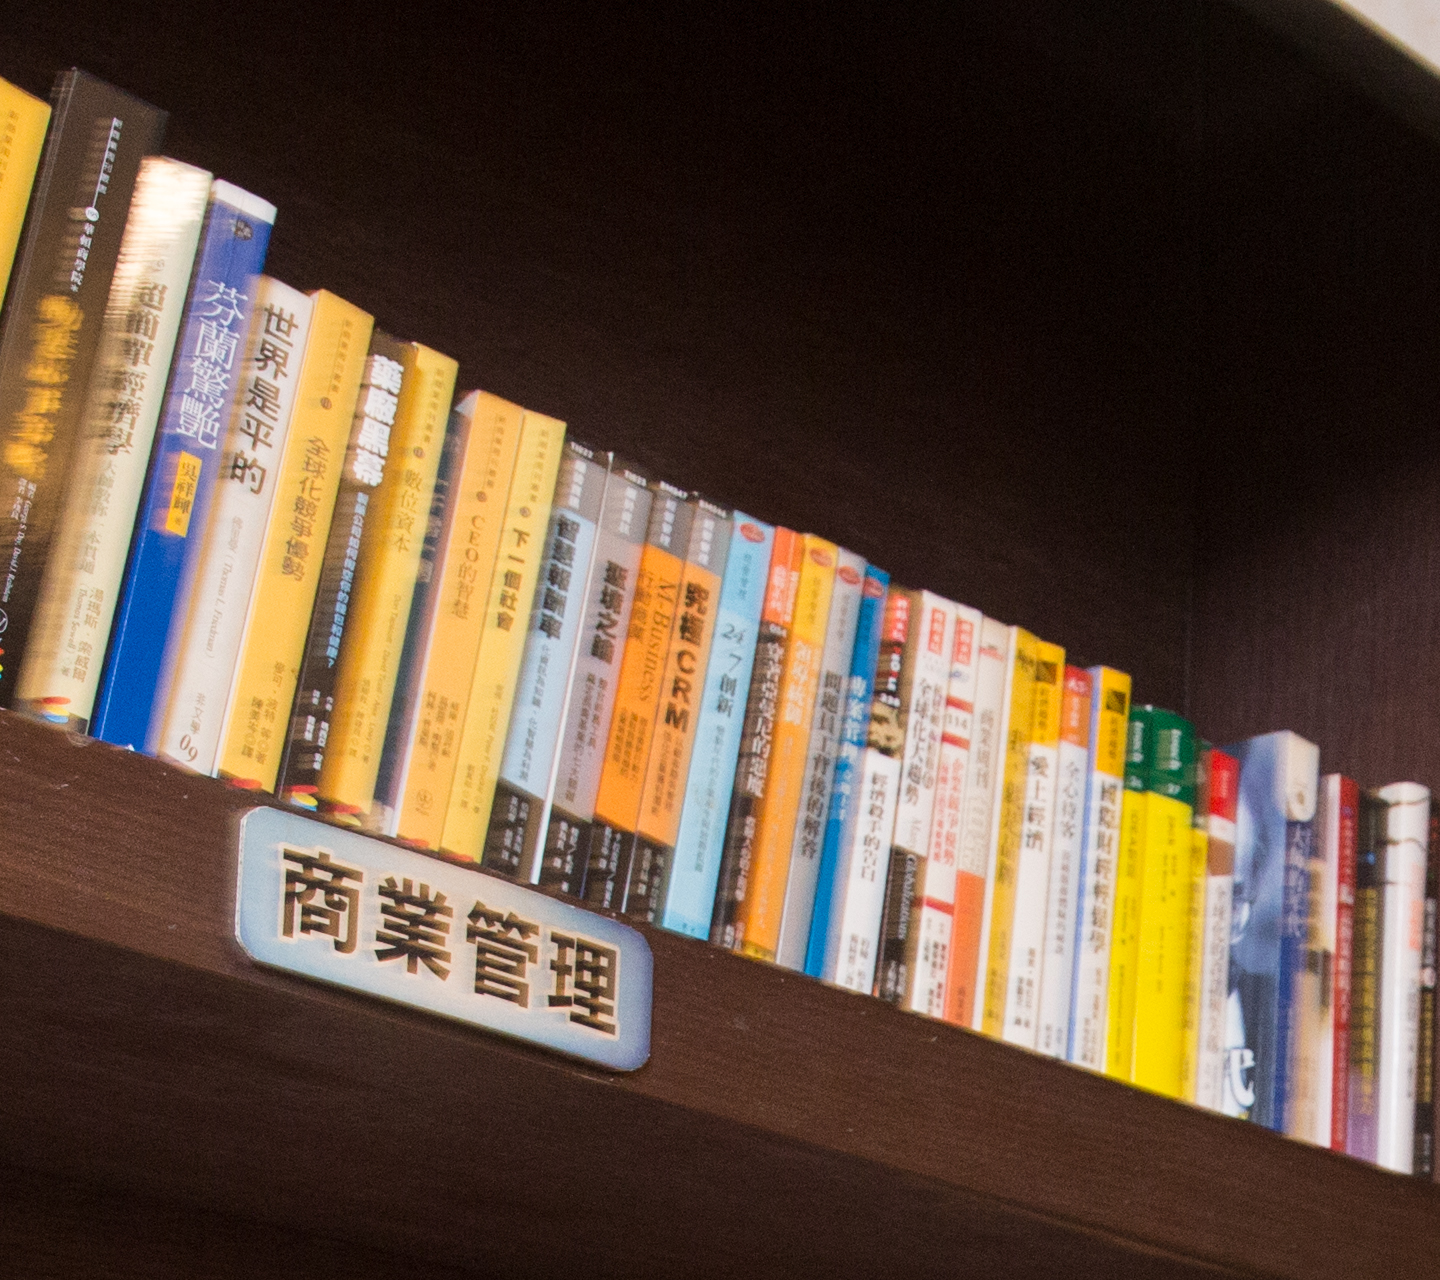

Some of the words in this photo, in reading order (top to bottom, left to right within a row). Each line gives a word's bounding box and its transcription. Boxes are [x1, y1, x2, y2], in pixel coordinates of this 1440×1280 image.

[231, 302, 300, 496] 世界是平的
[279, 437, 330, 583] 全球化競爭優勢
[394, 469, 422, 552] 數位資本
[280, 847, 621, 1038] 商業管理
